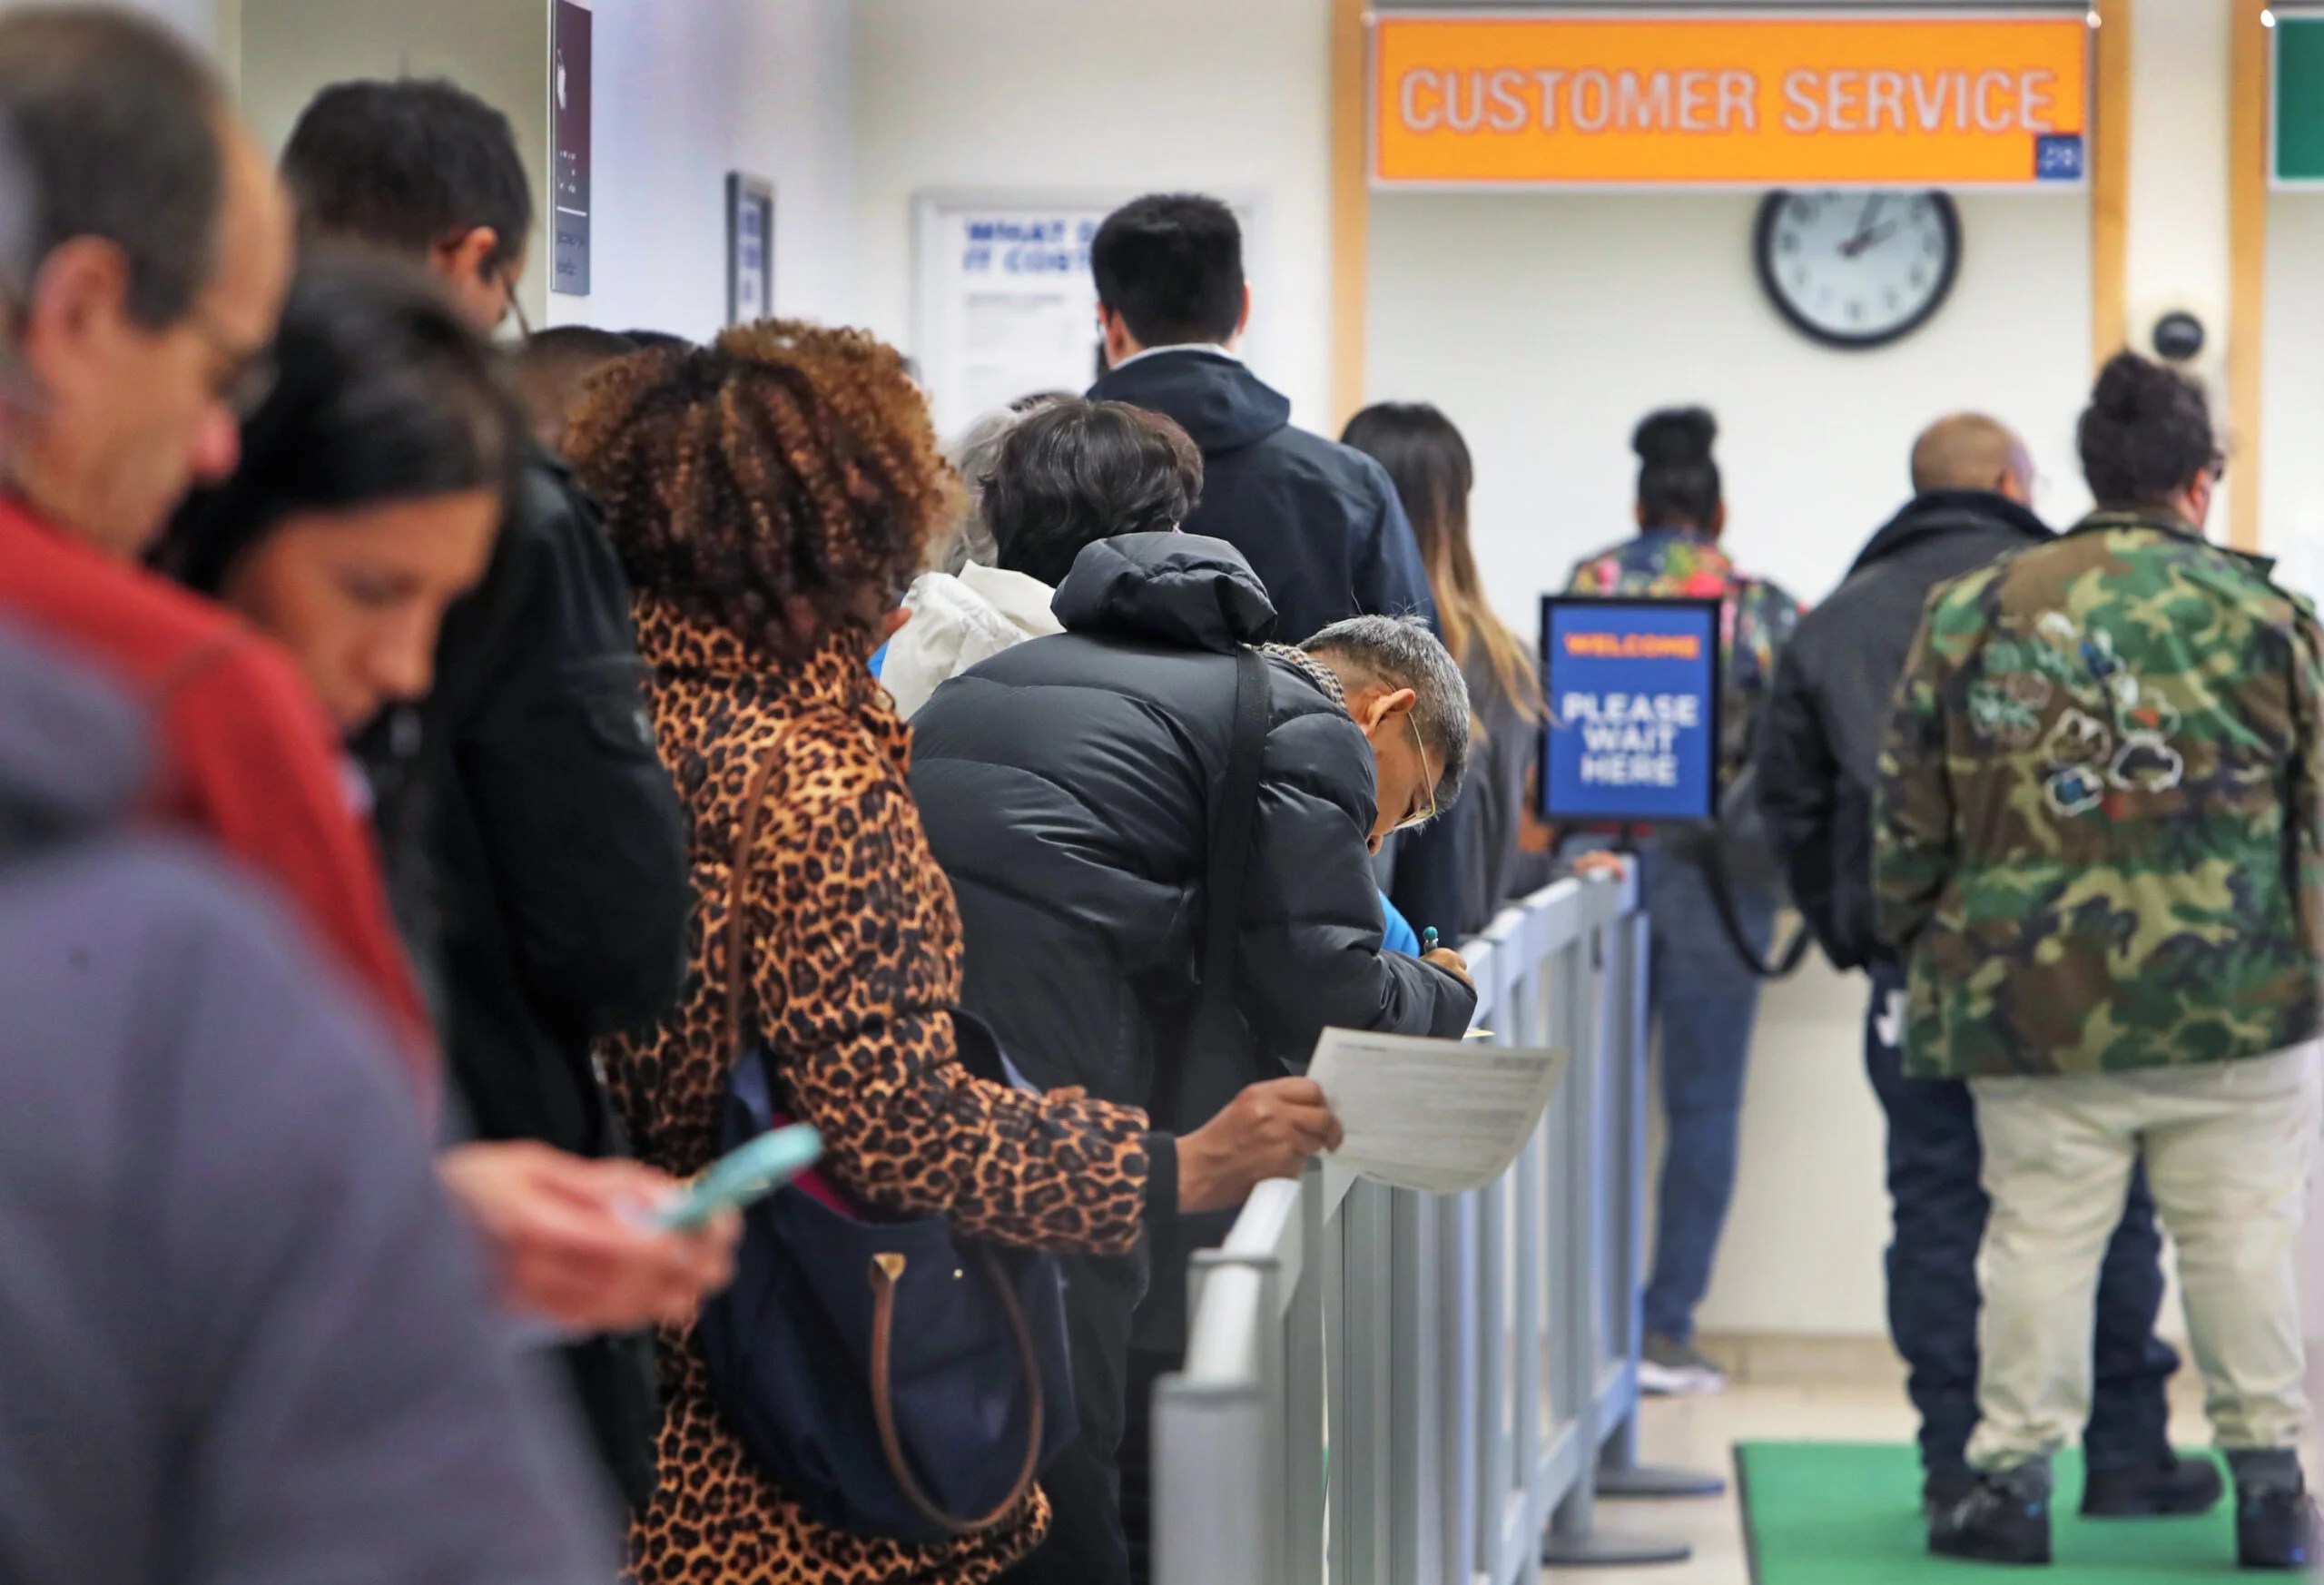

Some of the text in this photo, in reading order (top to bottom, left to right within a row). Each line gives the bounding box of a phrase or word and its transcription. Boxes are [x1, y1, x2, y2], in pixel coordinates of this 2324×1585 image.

[1399, 68, 2056, 133] CUSTOMER SERVICE
[1564, 633, 1699, 660] WELCOME
[1562, 692, 1698, 726] PLEASE
[1583, 724, 1677, 753] WAIT
[1581, 753, 1677, 787] HERE
